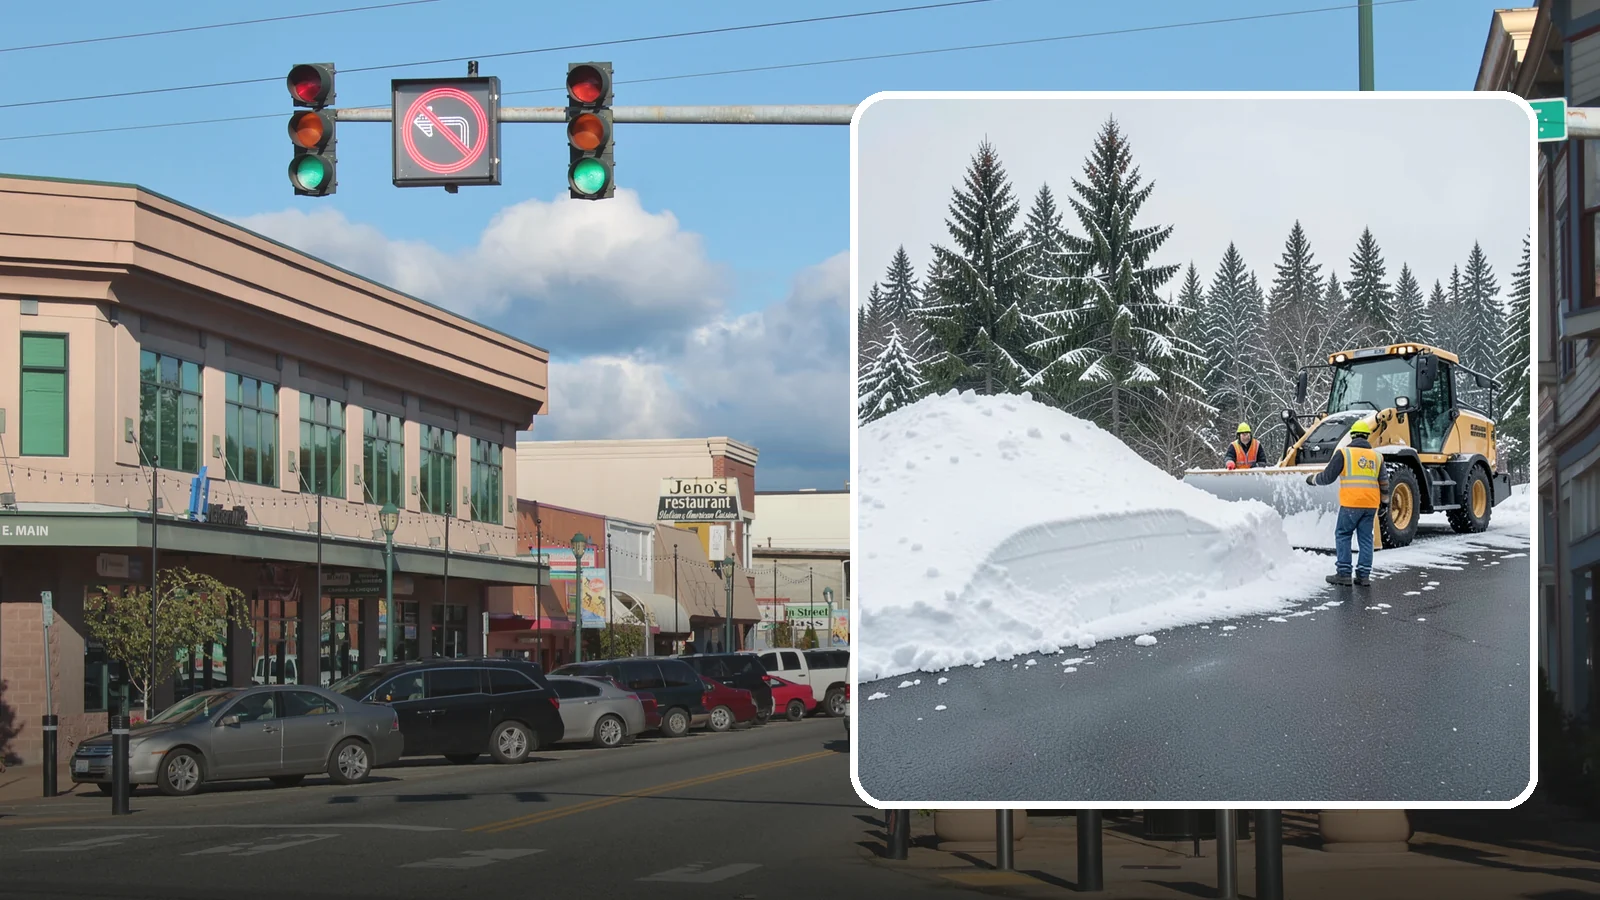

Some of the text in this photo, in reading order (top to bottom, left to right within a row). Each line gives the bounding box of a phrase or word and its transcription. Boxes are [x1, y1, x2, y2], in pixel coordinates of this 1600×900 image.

[669, 480, 728, 494] Jeno's
[665, 496, 731, 509] restaurant
[686, 509, 714, 519] American
[715, 509, 738, 519] Cuisine
[2, 525, 49, 536] E. MAIN
[797, 607, 828, 617] Street
